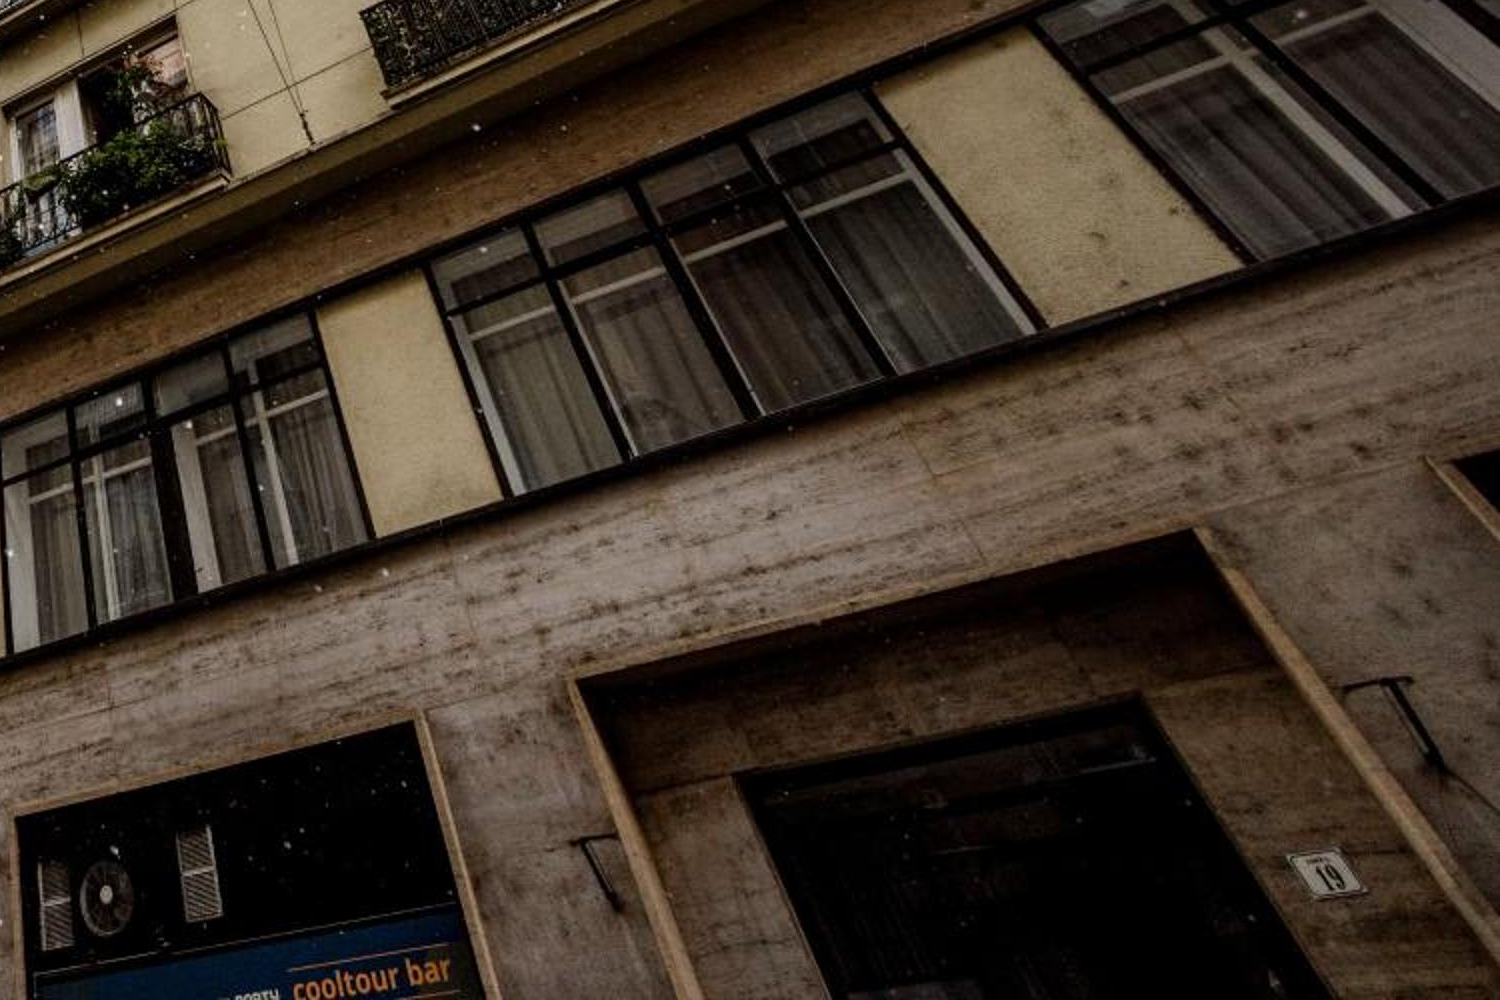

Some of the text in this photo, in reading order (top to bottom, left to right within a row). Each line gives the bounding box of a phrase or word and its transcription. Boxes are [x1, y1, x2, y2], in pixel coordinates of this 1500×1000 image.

[1316, 864, 1346, 890] 19
[293, 957, 450, 1000] cooltour bar
